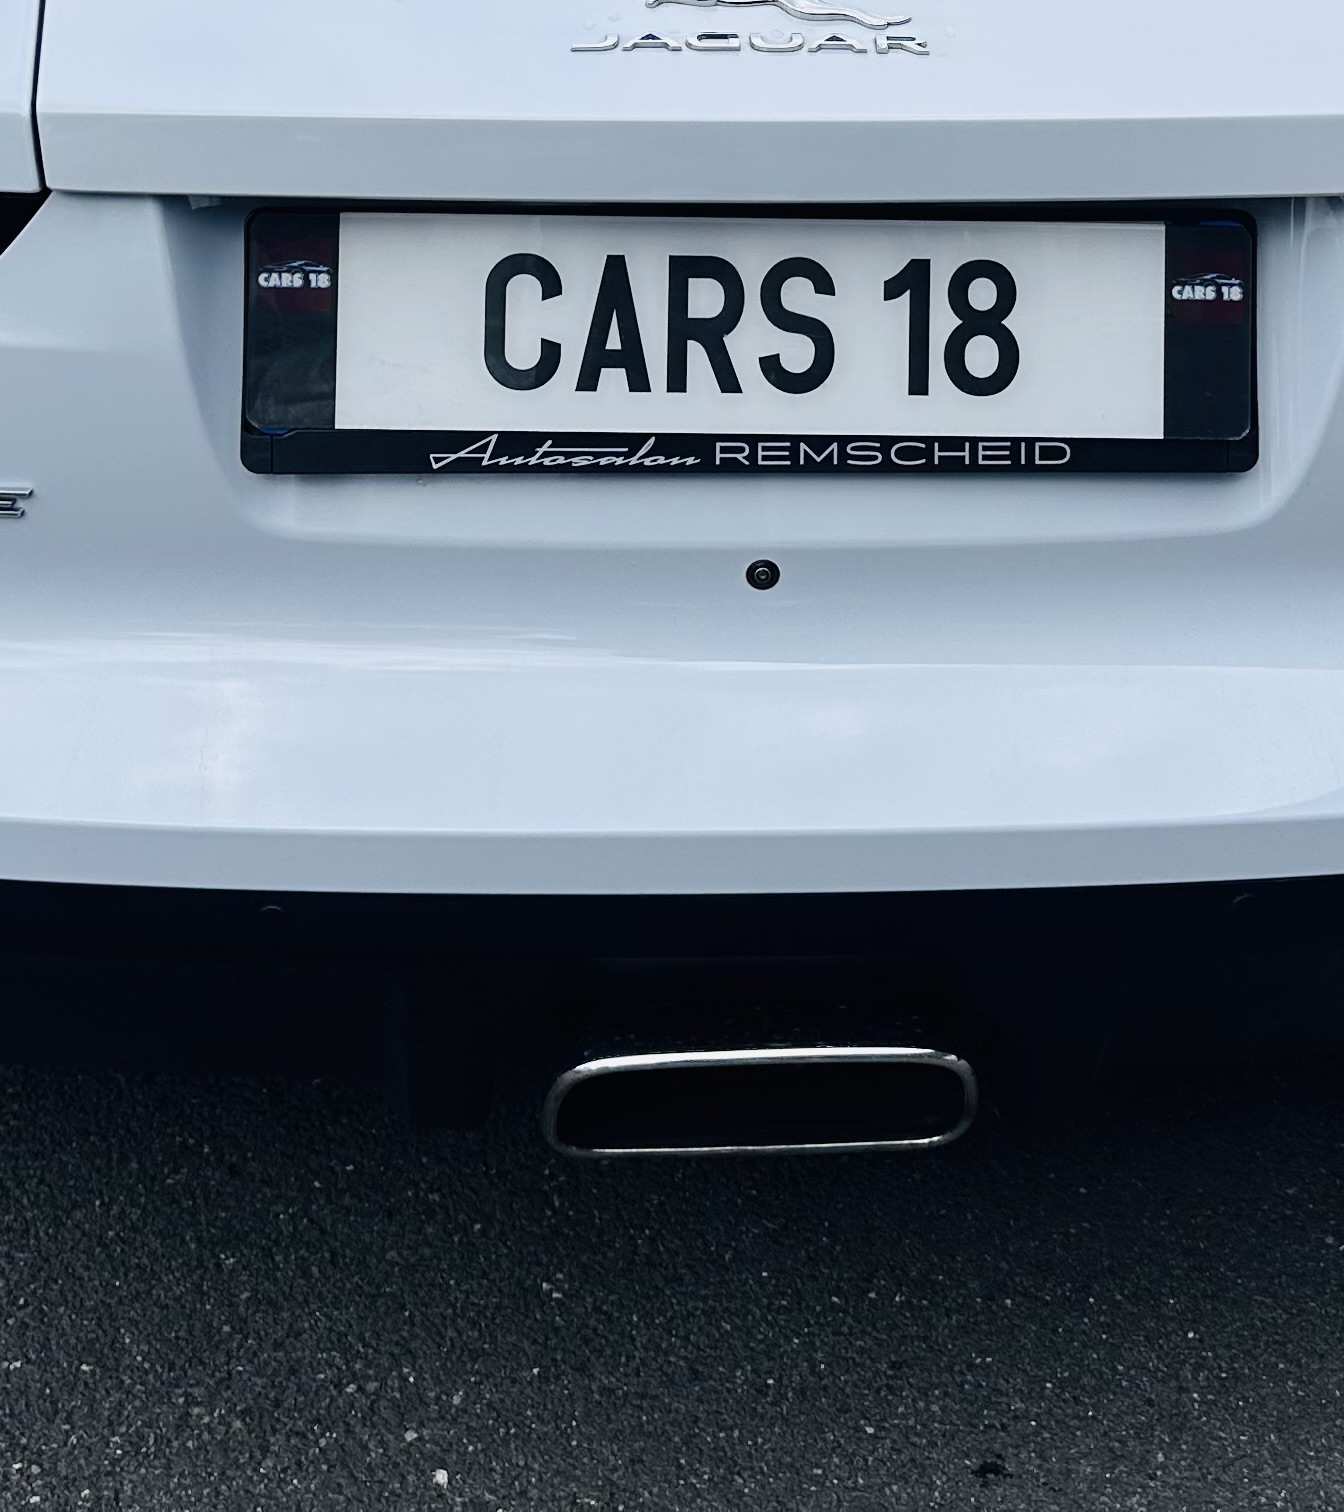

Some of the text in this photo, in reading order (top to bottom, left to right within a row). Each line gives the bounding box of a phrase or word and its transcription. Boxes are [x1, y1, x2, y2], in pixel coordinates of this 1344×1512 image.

[570, 31, 930, 55] JAGUAR
[258, 272, 332, 288] CARS 18
[1171, 285, 1244, 301] CARS 18
[483, 253, 1021, 397] CARS 18
[429, 433, 1071, 469] Autosalon REMSCHEID
